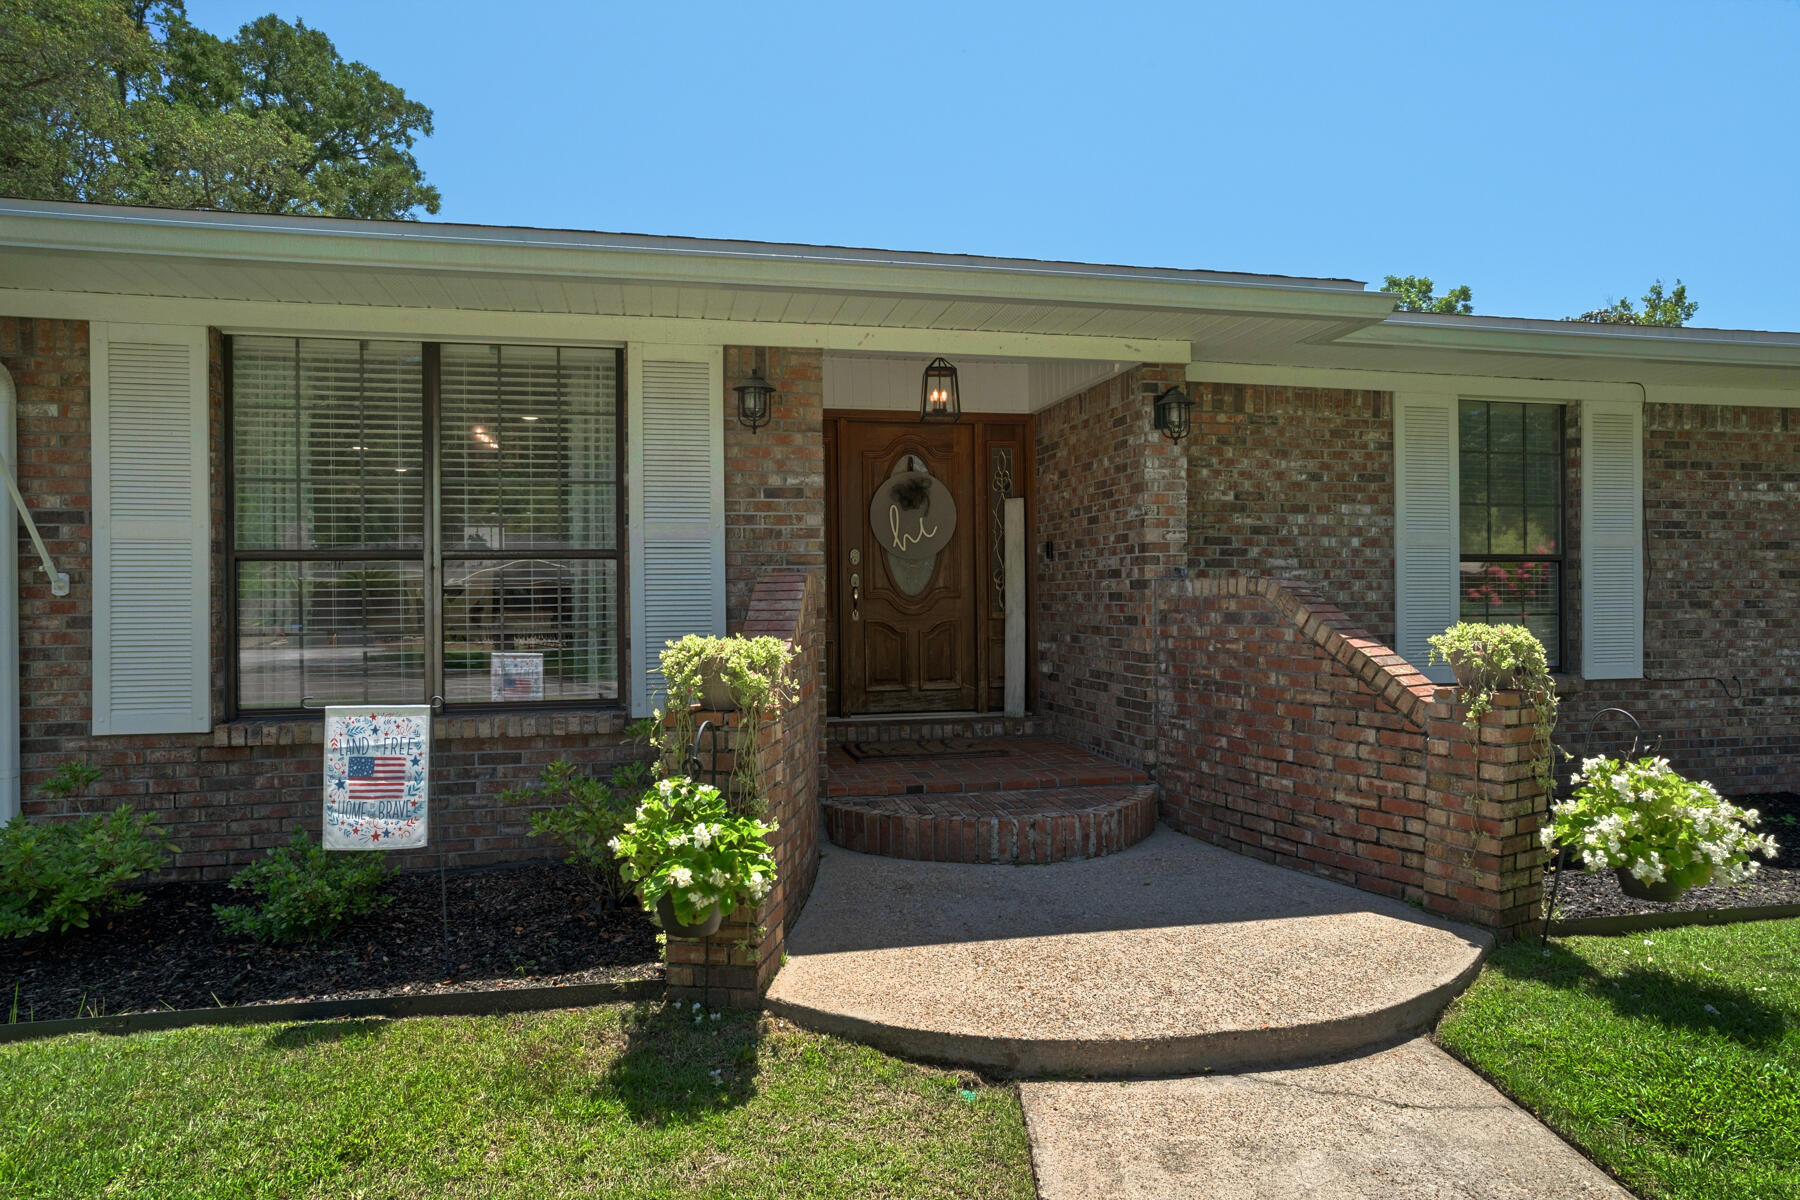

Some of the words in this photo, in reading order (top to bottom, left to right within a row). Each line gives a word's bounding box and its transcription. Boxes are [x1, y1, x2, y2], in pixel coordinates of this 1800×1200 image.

[889, 504, 938, 551] hi
[339, 737, 370, 756] LAND
[383, 737, 416, 756] FREE
[338, 800, 368, 820] HOME
[378, 800, 412, 819] BRAVE
